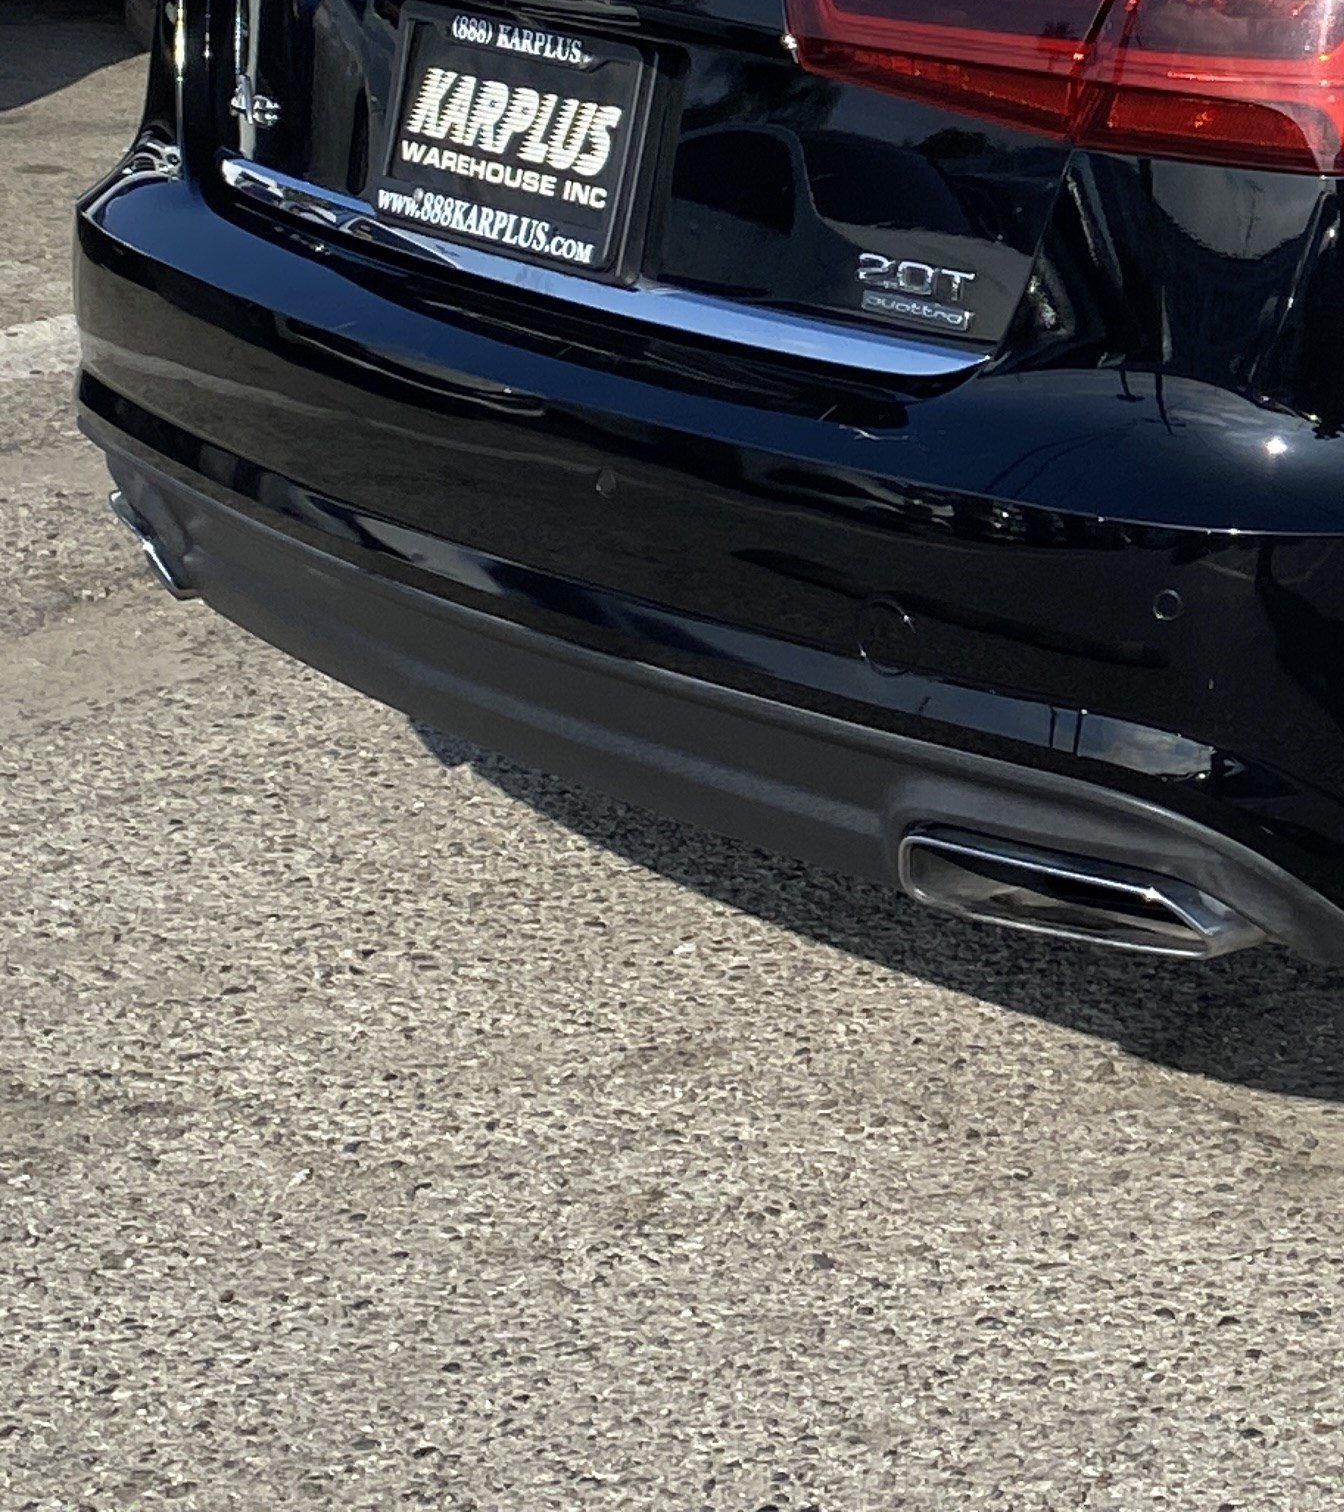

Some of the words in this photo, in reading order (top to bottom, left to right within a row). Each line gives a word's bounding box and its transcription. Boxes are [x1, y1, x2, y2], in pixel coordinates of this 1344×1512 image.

[452, 15, 493, 44] (888)
[496, 24, 583, 63] KARPLUS
[406, 67, 622, 176] KARPLUS
[401, 139, 558, 197] WAREHOUSE
[562, 179, 608, 209] INC
[866, 295, 963, 325] quattro
